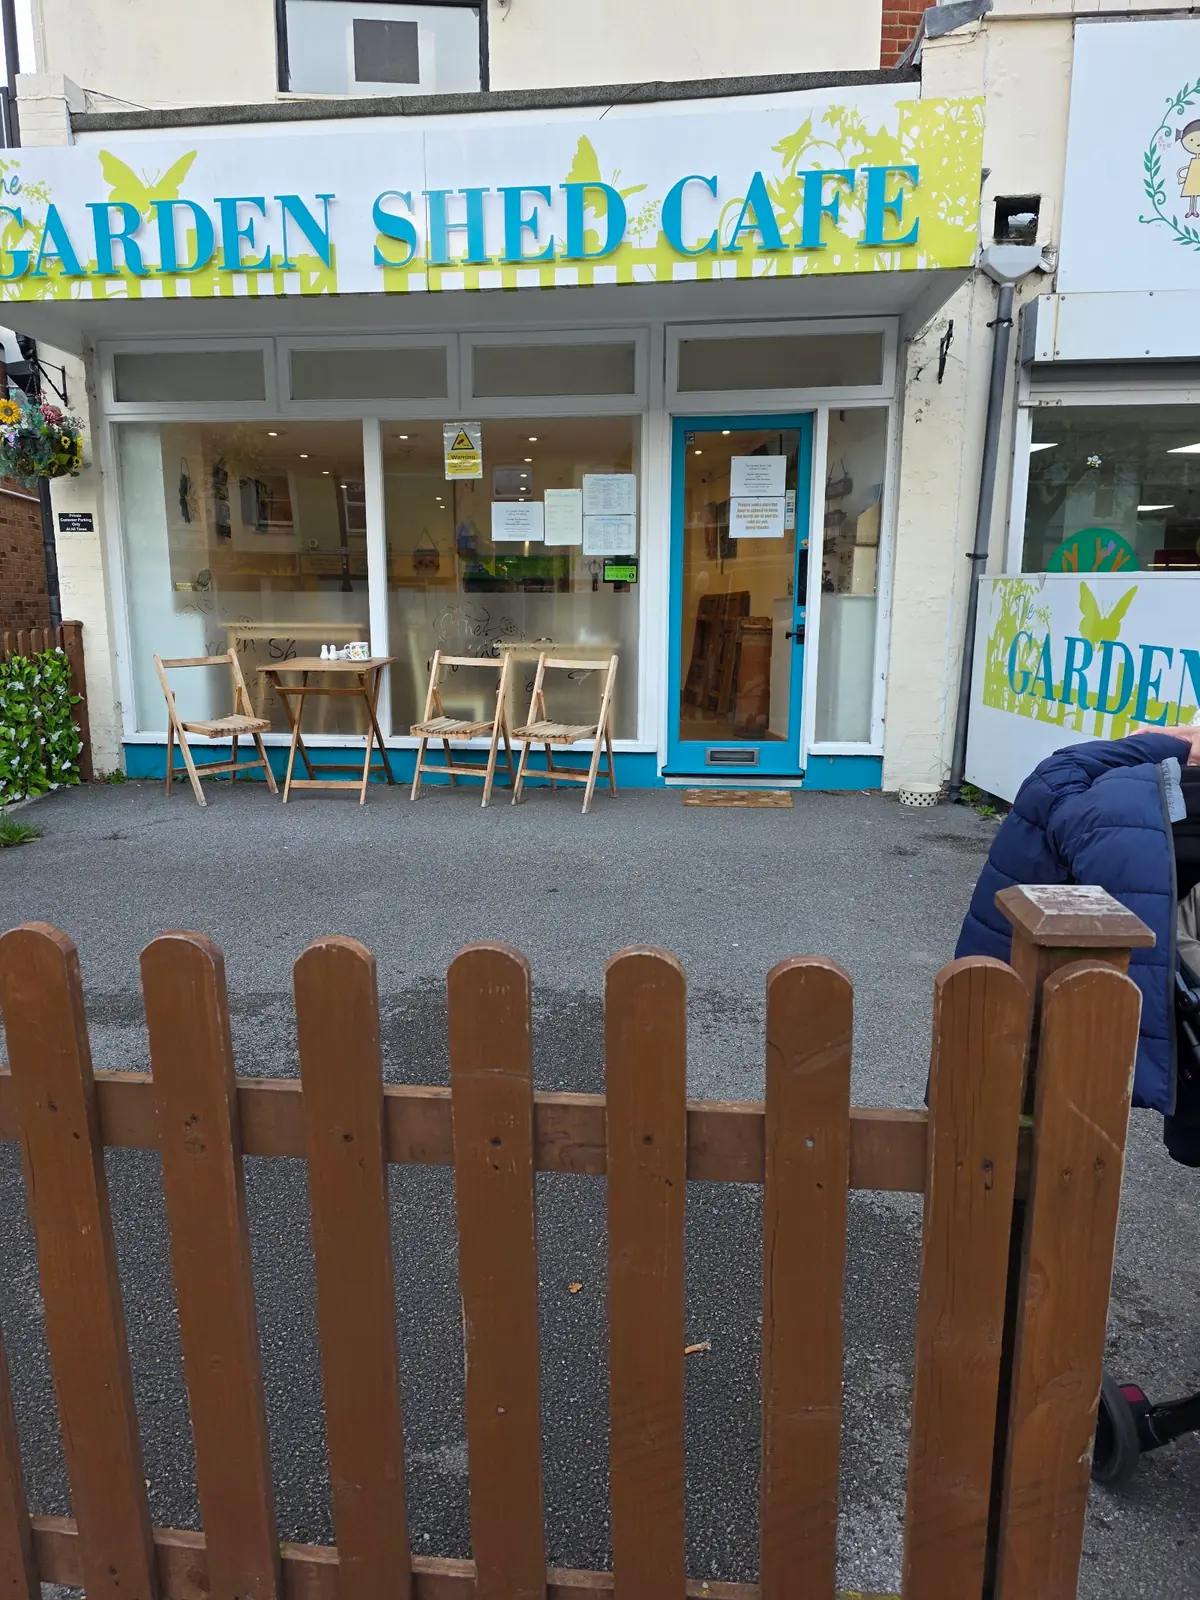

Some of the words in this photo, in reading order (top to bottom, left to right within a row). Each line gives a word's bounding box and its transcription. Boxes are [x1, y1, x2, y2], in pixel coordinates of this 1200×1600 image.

[0, 193, 336, 280] GARDEN
[372, 181, 628, 269] SHED
[660, 164, 921, 256] CAFE
[1008, 631, 1200, 727] GARDEN
